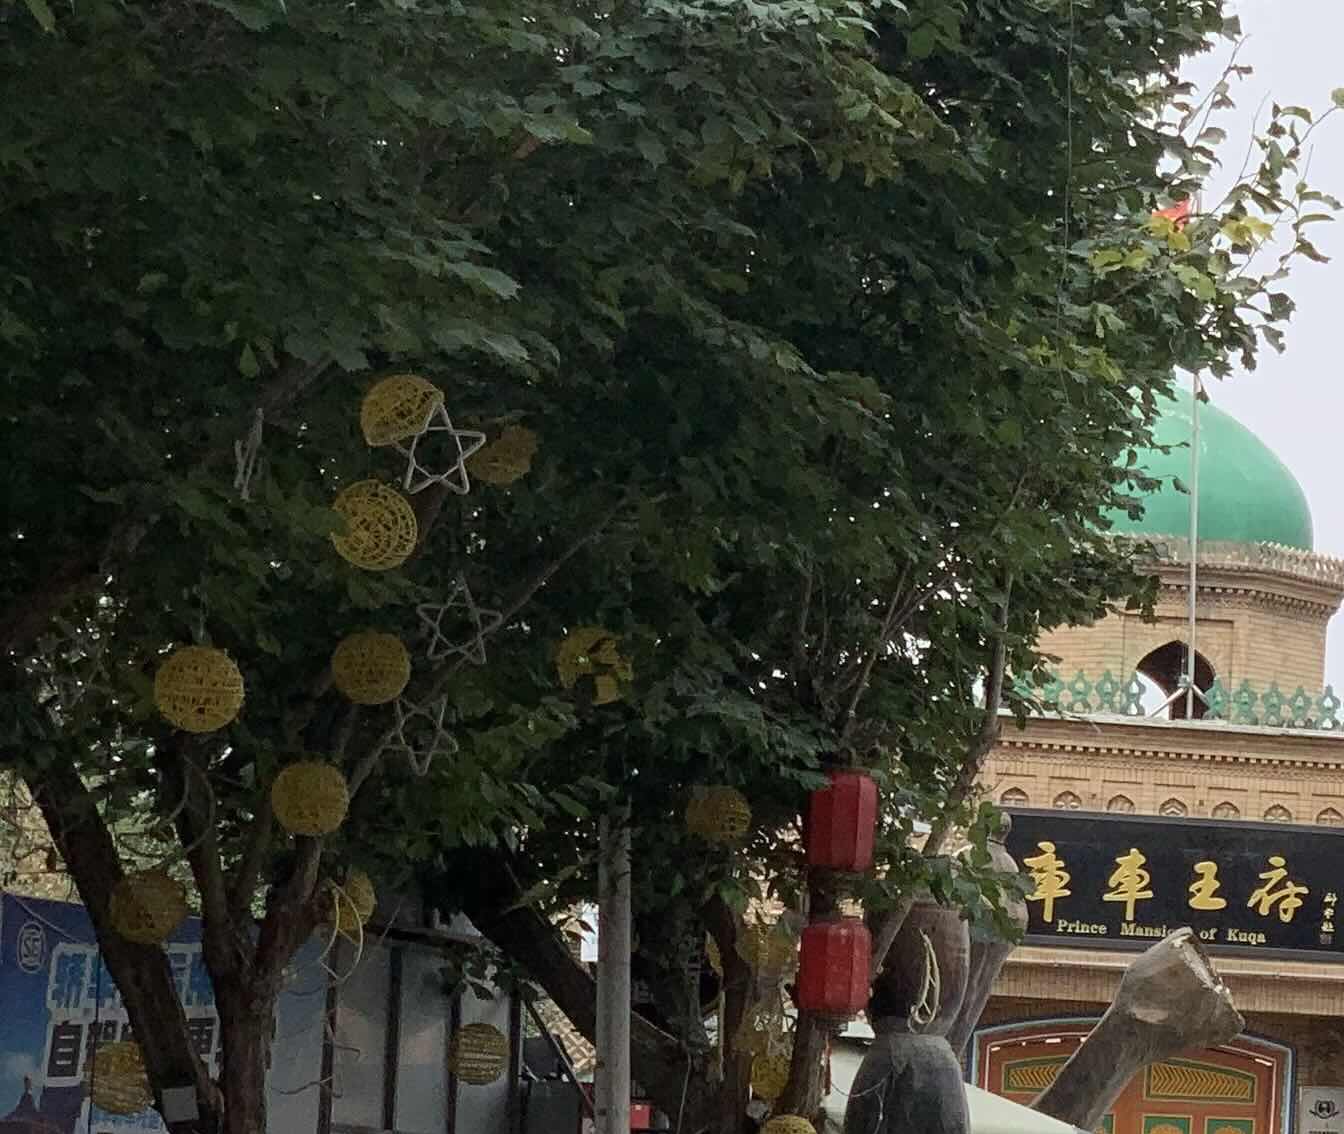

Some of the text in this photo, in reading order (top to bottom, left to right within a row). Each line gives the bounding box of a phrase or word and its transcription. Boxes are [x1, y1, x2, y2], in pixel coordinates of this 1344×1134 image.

[1056, 919, 1267, 945] Prince Mansi of Kuqa
